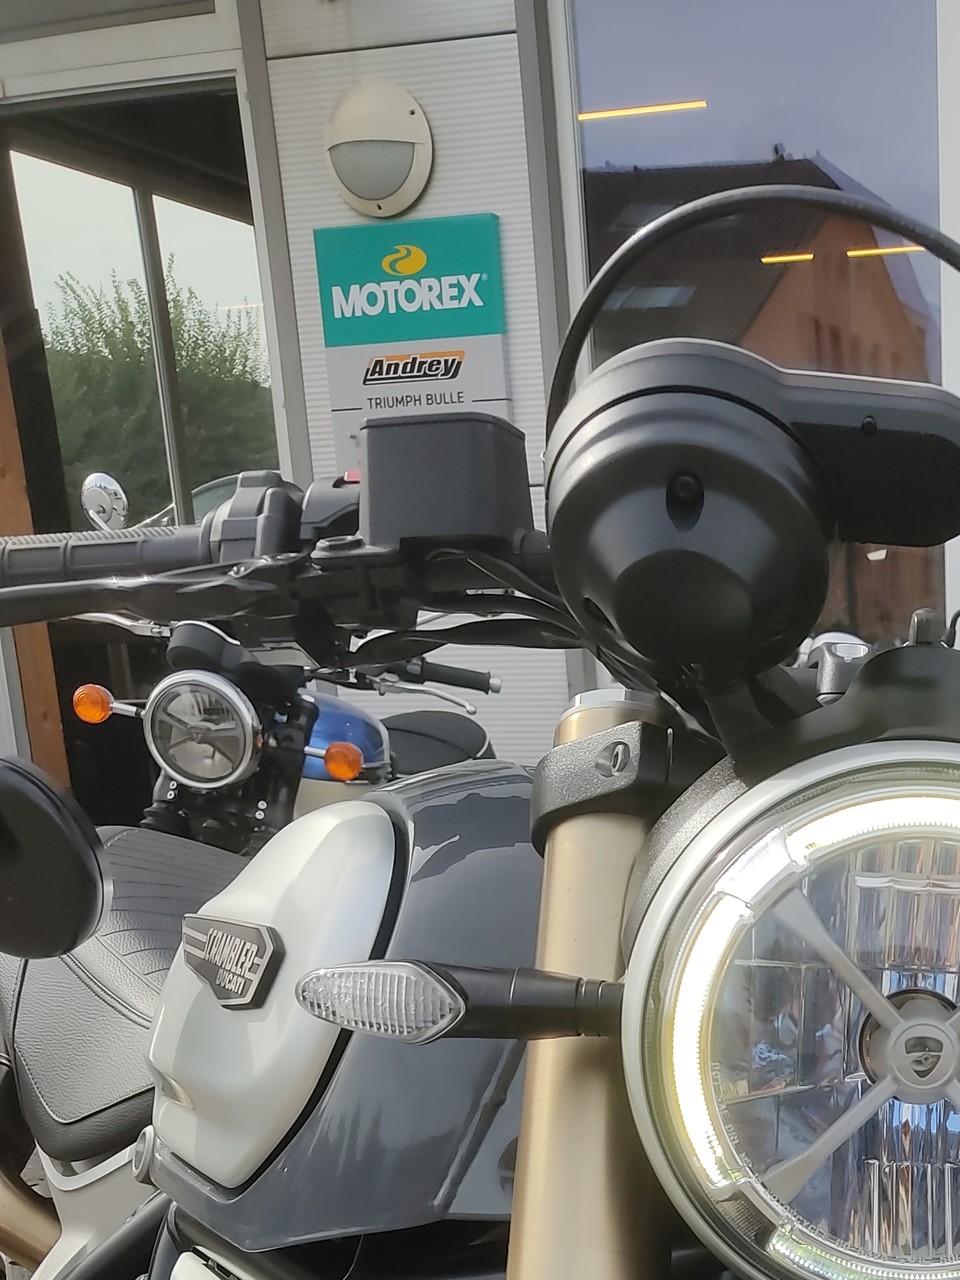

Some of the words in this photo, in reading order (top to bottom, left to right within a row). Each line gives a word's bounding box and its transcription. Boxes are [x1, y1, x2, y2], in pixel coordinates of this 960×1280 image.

[331, 273, 484, 319] MOTOREX
[369, 356, 461, 379] Andrey
[367, 394, 422, 410] TRIUMPH
[426, 391, 465, 406] BULLE
[204, 927, 259, 977] SCRAMBLER
[215, 968, 247, 995] DUCATI
